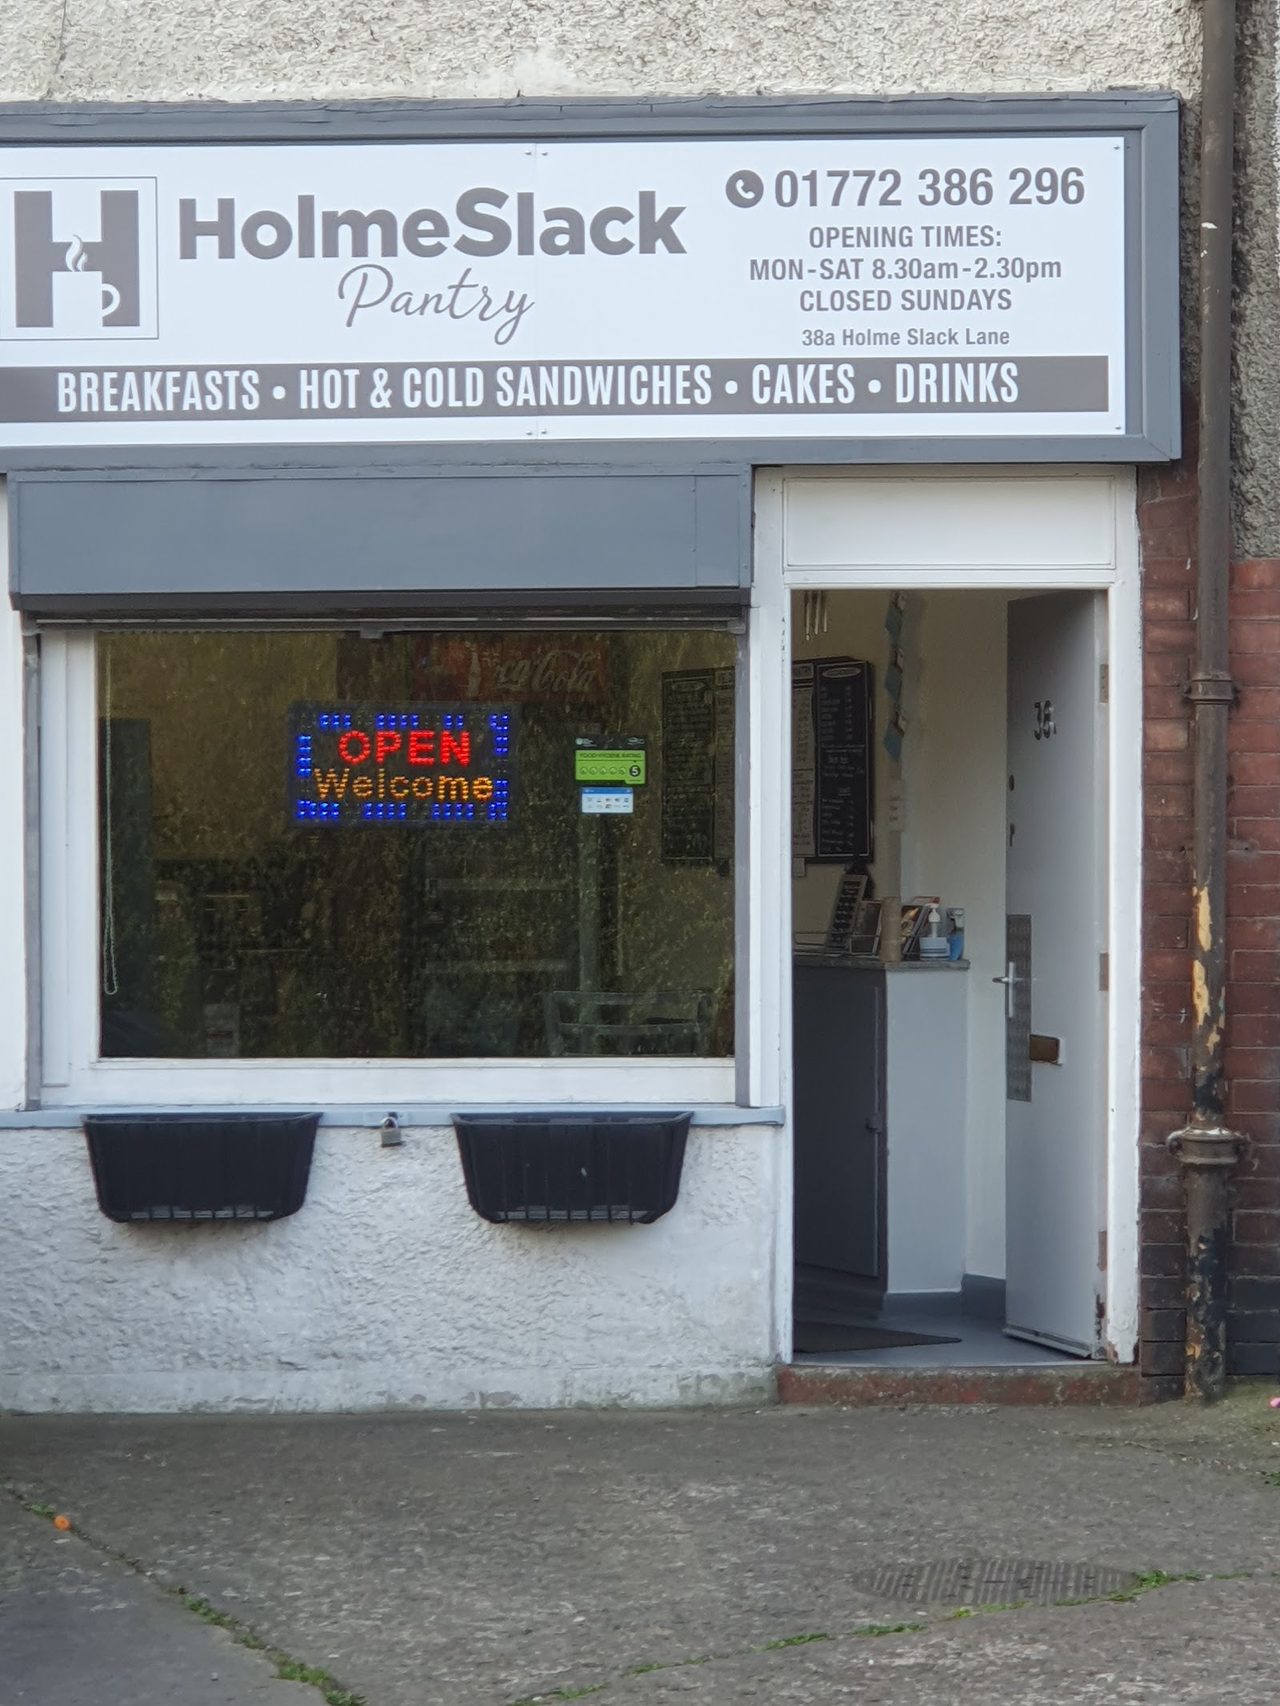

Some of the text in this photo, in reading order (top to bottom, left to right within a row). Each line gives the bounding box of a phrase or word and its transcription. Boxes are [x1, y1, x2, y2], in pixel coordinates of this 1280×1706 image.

[775, 167, 1084, 207] 01772 386 296
[180, 188, 687, 259] HolmeSlack
[810, 225, 1001, 248] OPENING TIMES:
[751, 257, 1061, 283] MON-SAT 8.30am-2.30pm
[338, 264, 535, 345] Pantry
[800, 289, 1011, 311] CLOSED SUNDAYS
[802, 328, 1009, 346] 38a Holme Slack Lane
[59, 363, 1018, 412] BREAKFASTS HOT & COLD SANDWICHES CAKES DRINKS
[338, 730, 471, 766] OPEN
[313, 768, 493, 800] Welcome
